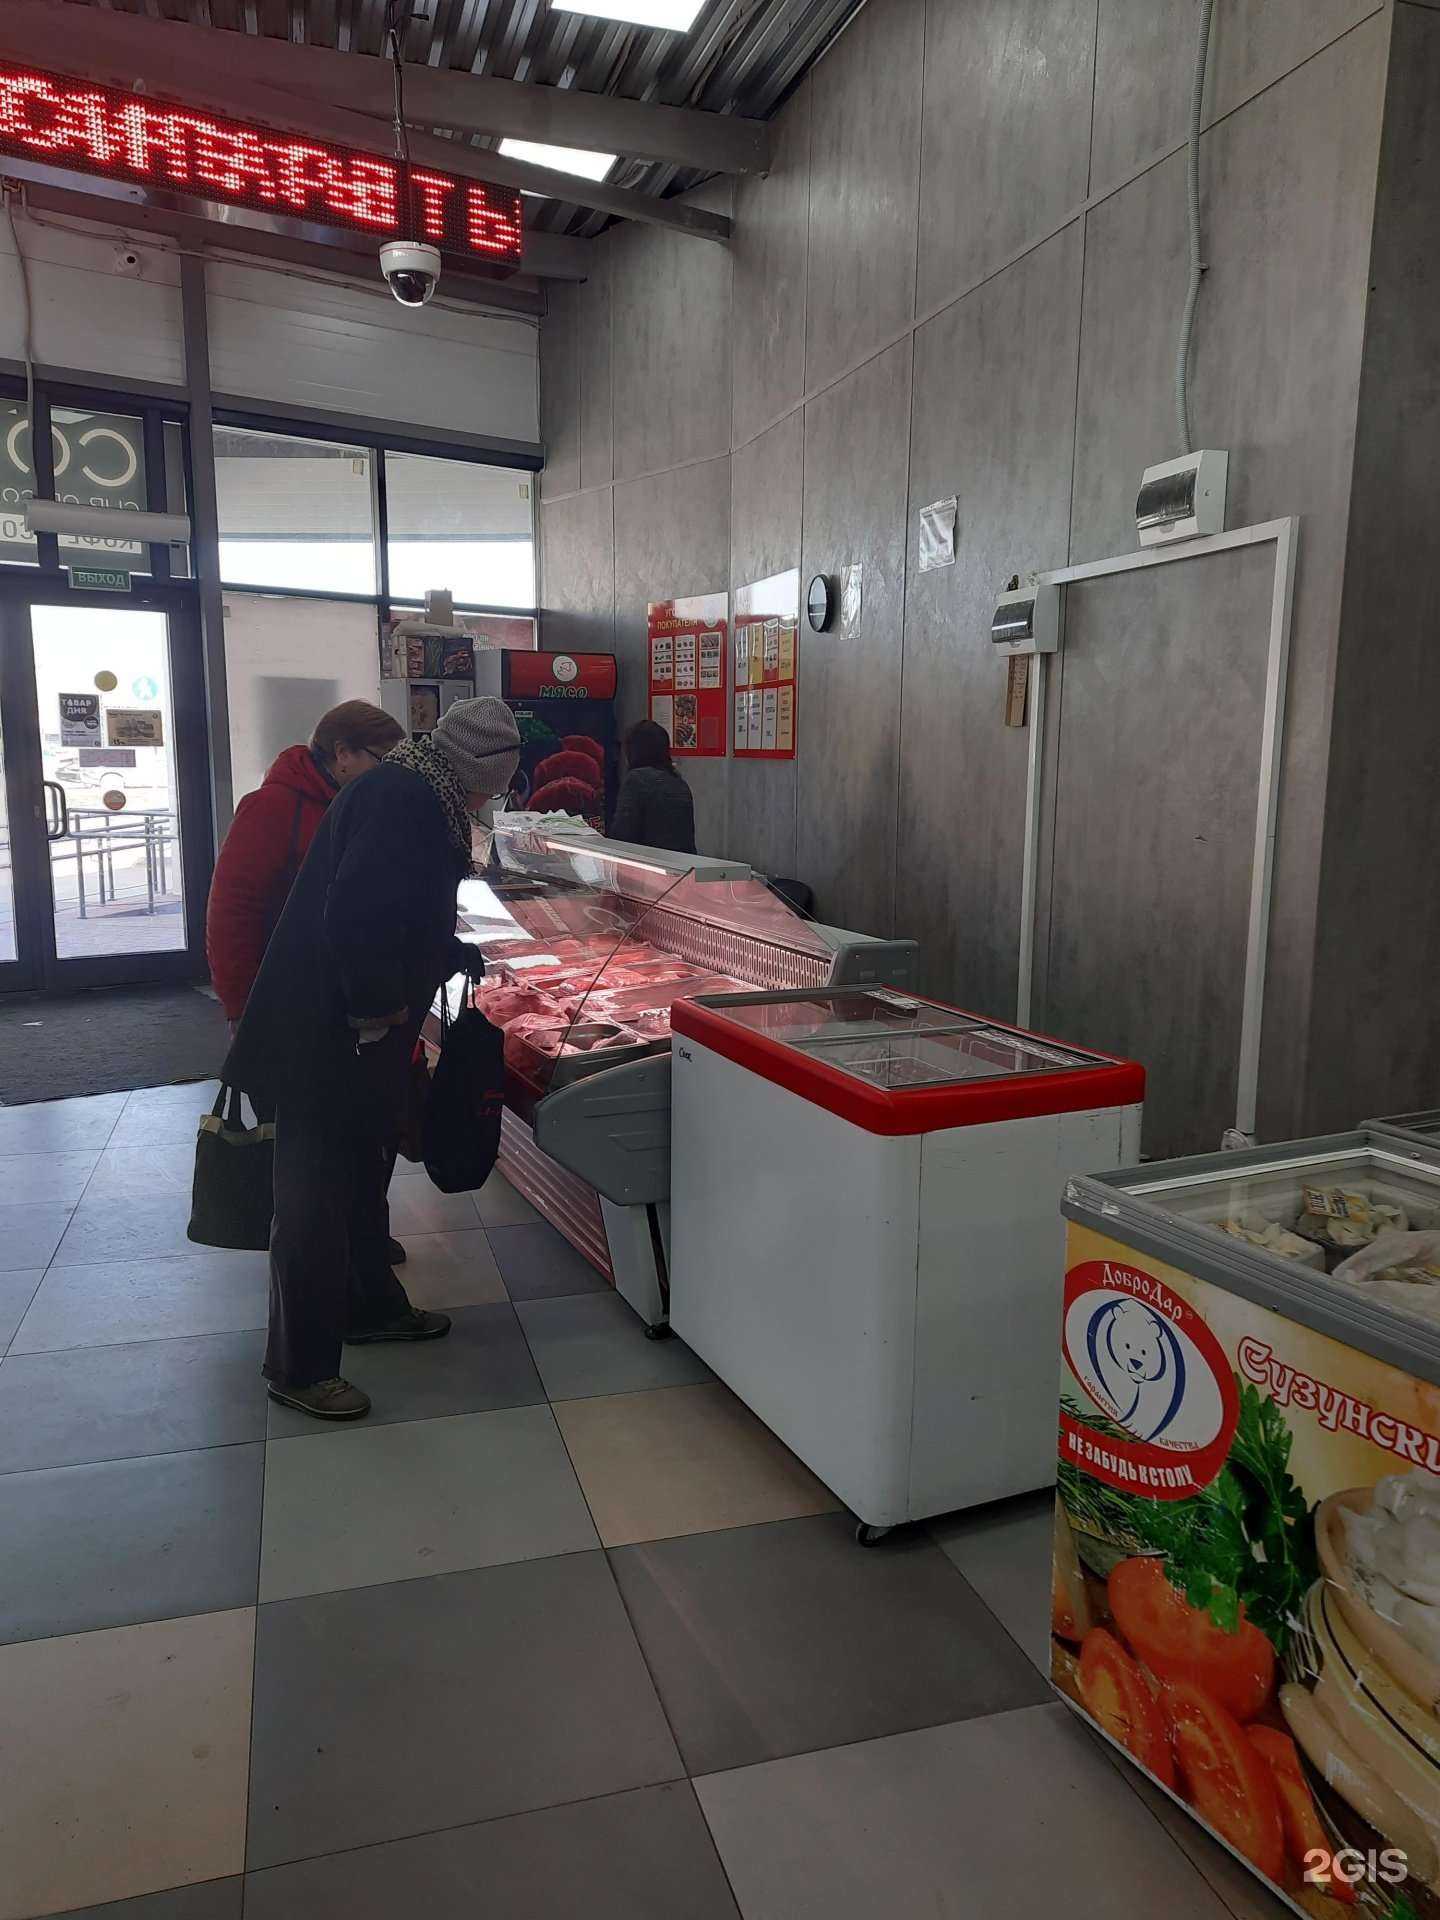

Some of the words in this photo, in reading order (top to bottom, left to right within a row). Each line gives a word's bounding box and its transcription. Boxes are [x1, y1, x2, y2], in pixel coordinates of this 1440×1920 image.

[78, 573, 126, 588] ВЫХОД
[539, 685, 588, 698] МЯСО
[1068, 1431, 1084, 1455] НЕ
[1085, 1443, 1137, 1481] ЗАБУДЬ
